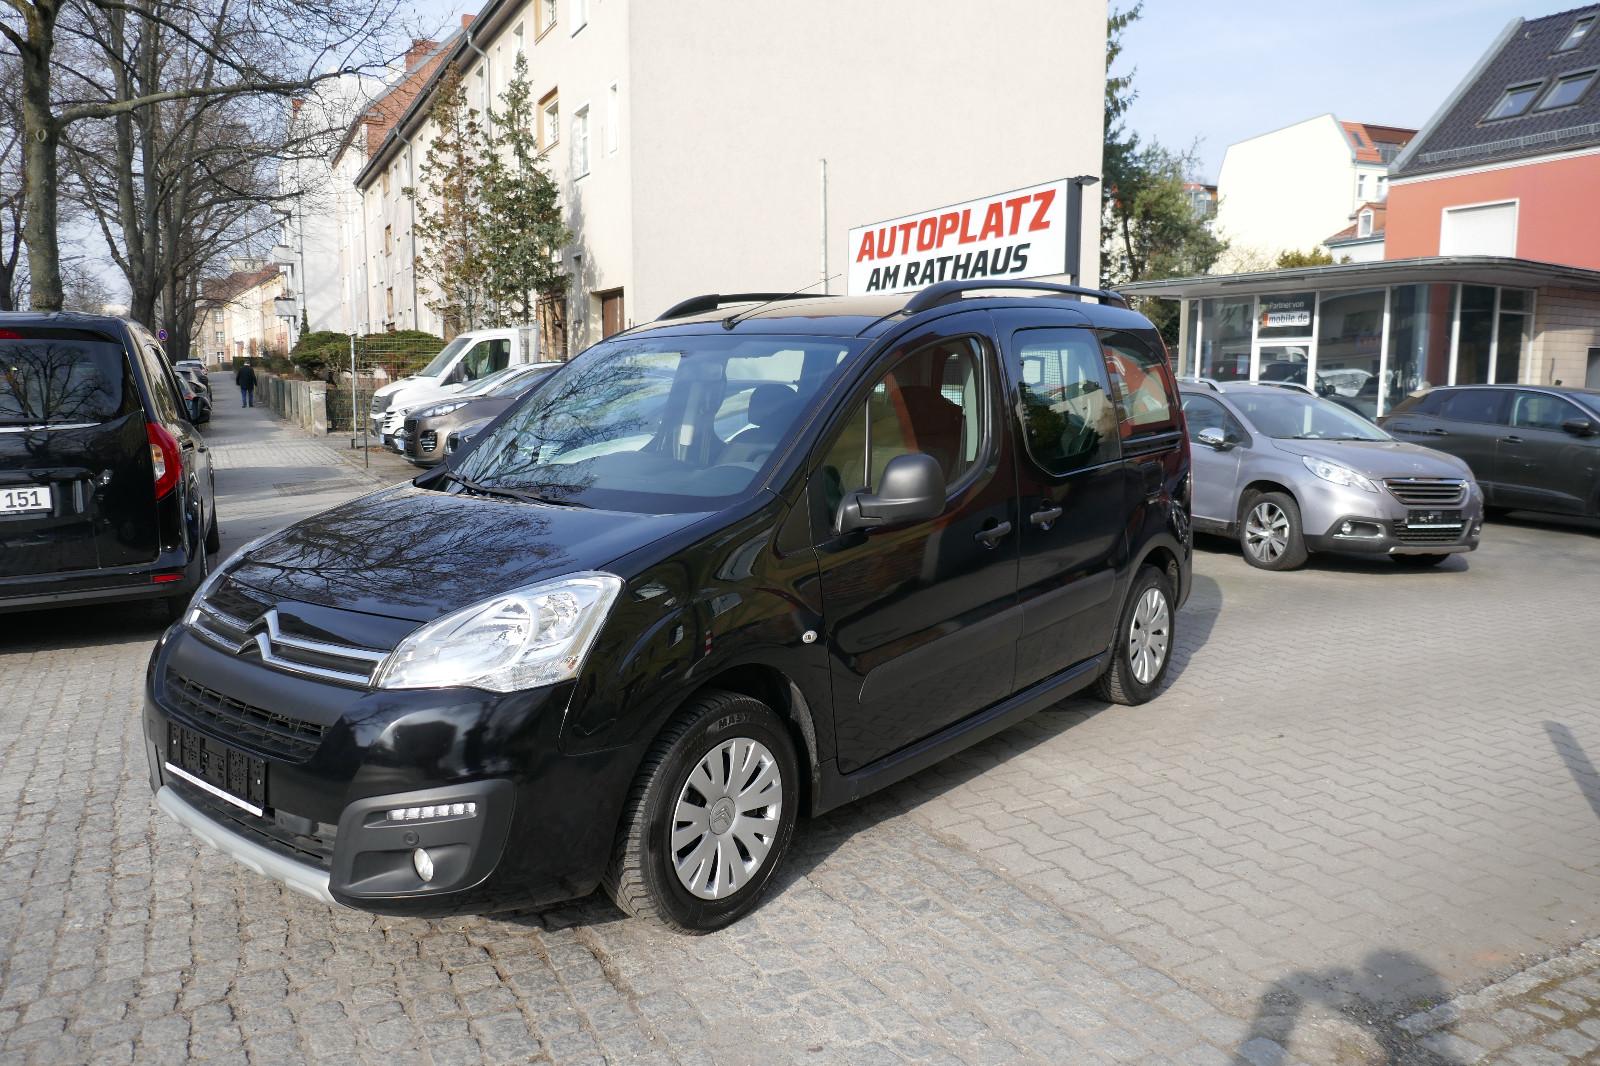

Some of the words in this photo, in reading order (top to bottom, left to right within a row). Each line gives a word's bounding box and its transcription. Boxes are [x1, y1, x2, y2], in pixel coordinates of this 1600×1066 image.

[856, 189, 1056, 263] AUTOPLATZ
[866, 264, 900, 292] AM
[903, 243, 1031, 287] RATHAUS
[1268, 312, 1308, 324] mobile.de
[5, 490, 42, 508] 151
